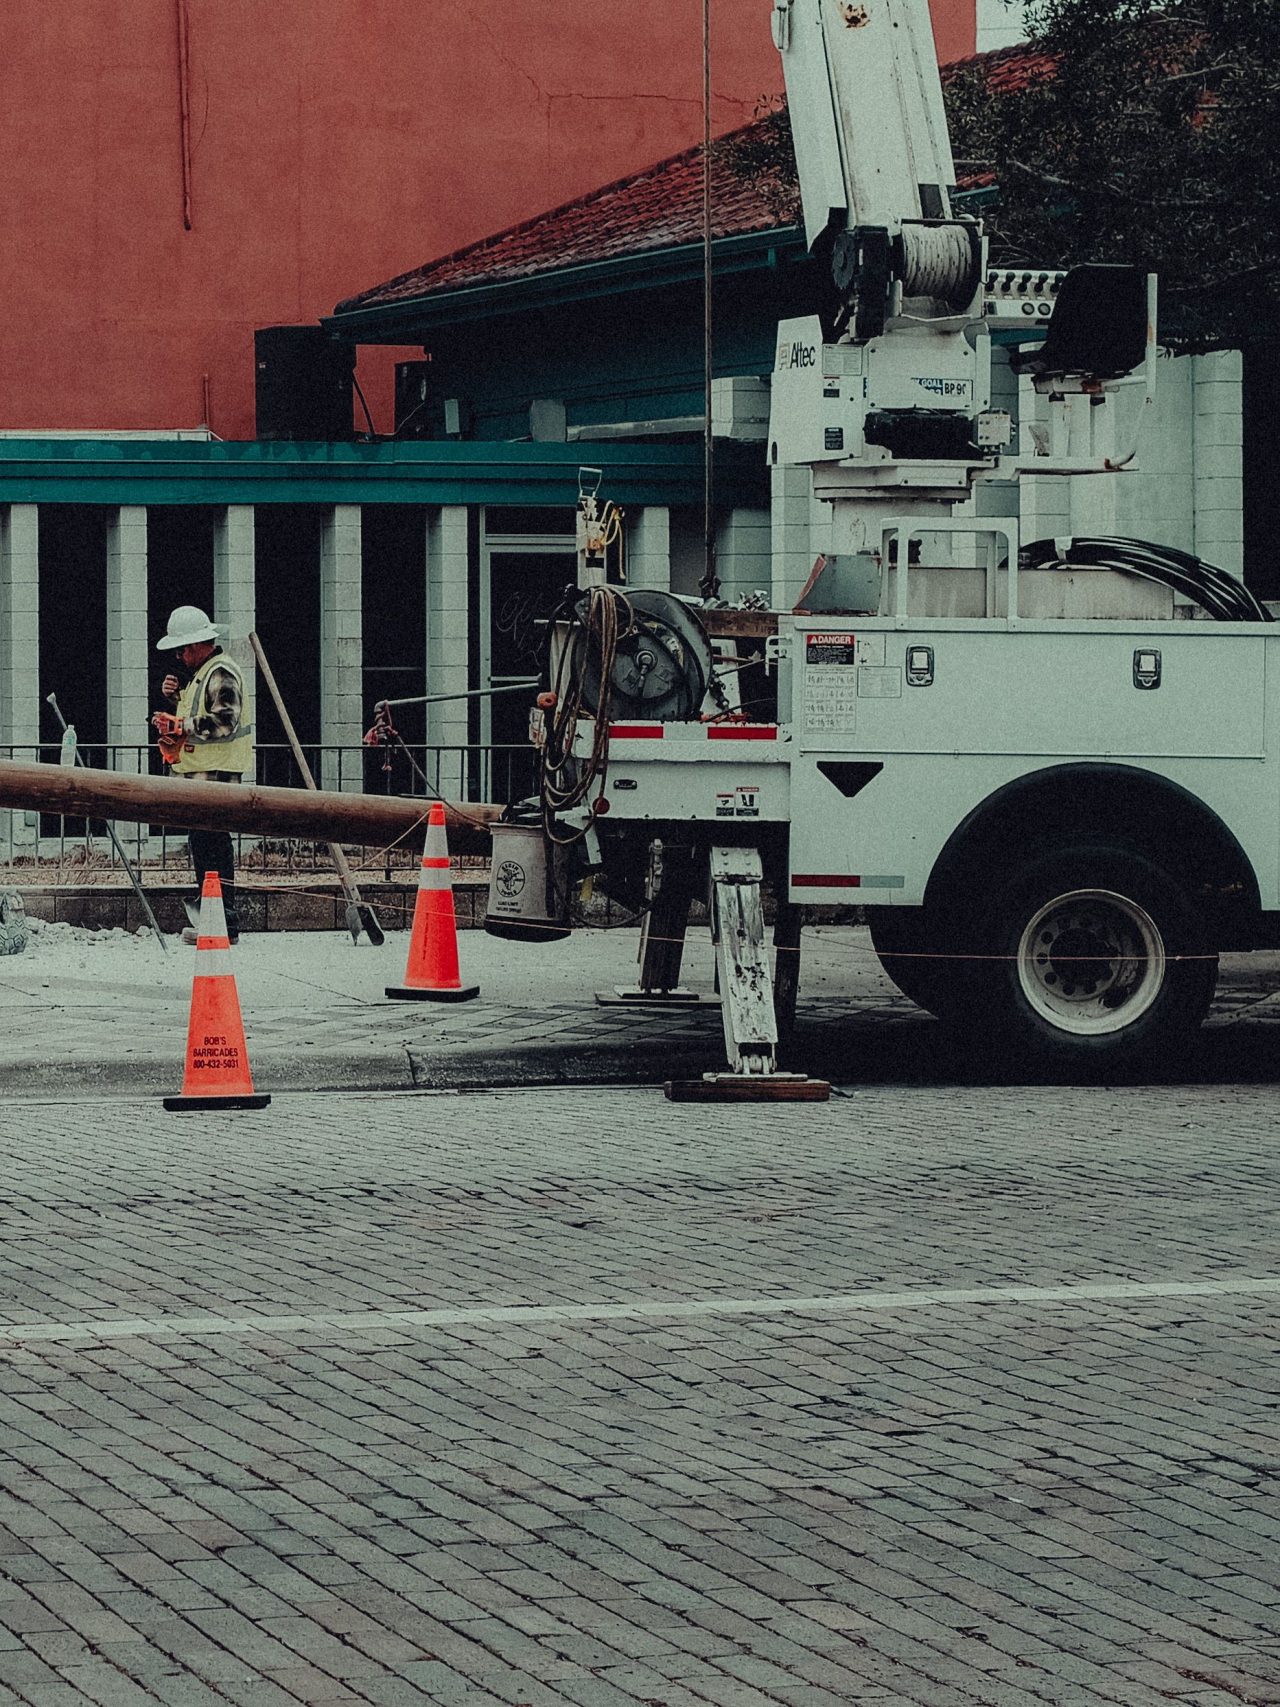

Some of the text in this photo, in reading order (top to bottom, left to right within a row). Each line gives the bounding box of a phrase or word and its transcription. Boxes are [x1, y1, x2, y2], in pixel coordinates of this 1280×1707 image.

[790, 342, 815, 368] Altec
[945, 383, 955, 394] BP
[818, 635, 851, 644] DANGER
[204, 1036, 226, 1045] BOB'S
[193, 1048, 238, 1057] BARRICADES
[193, 1059, 238, 1068] 800-432-5031
